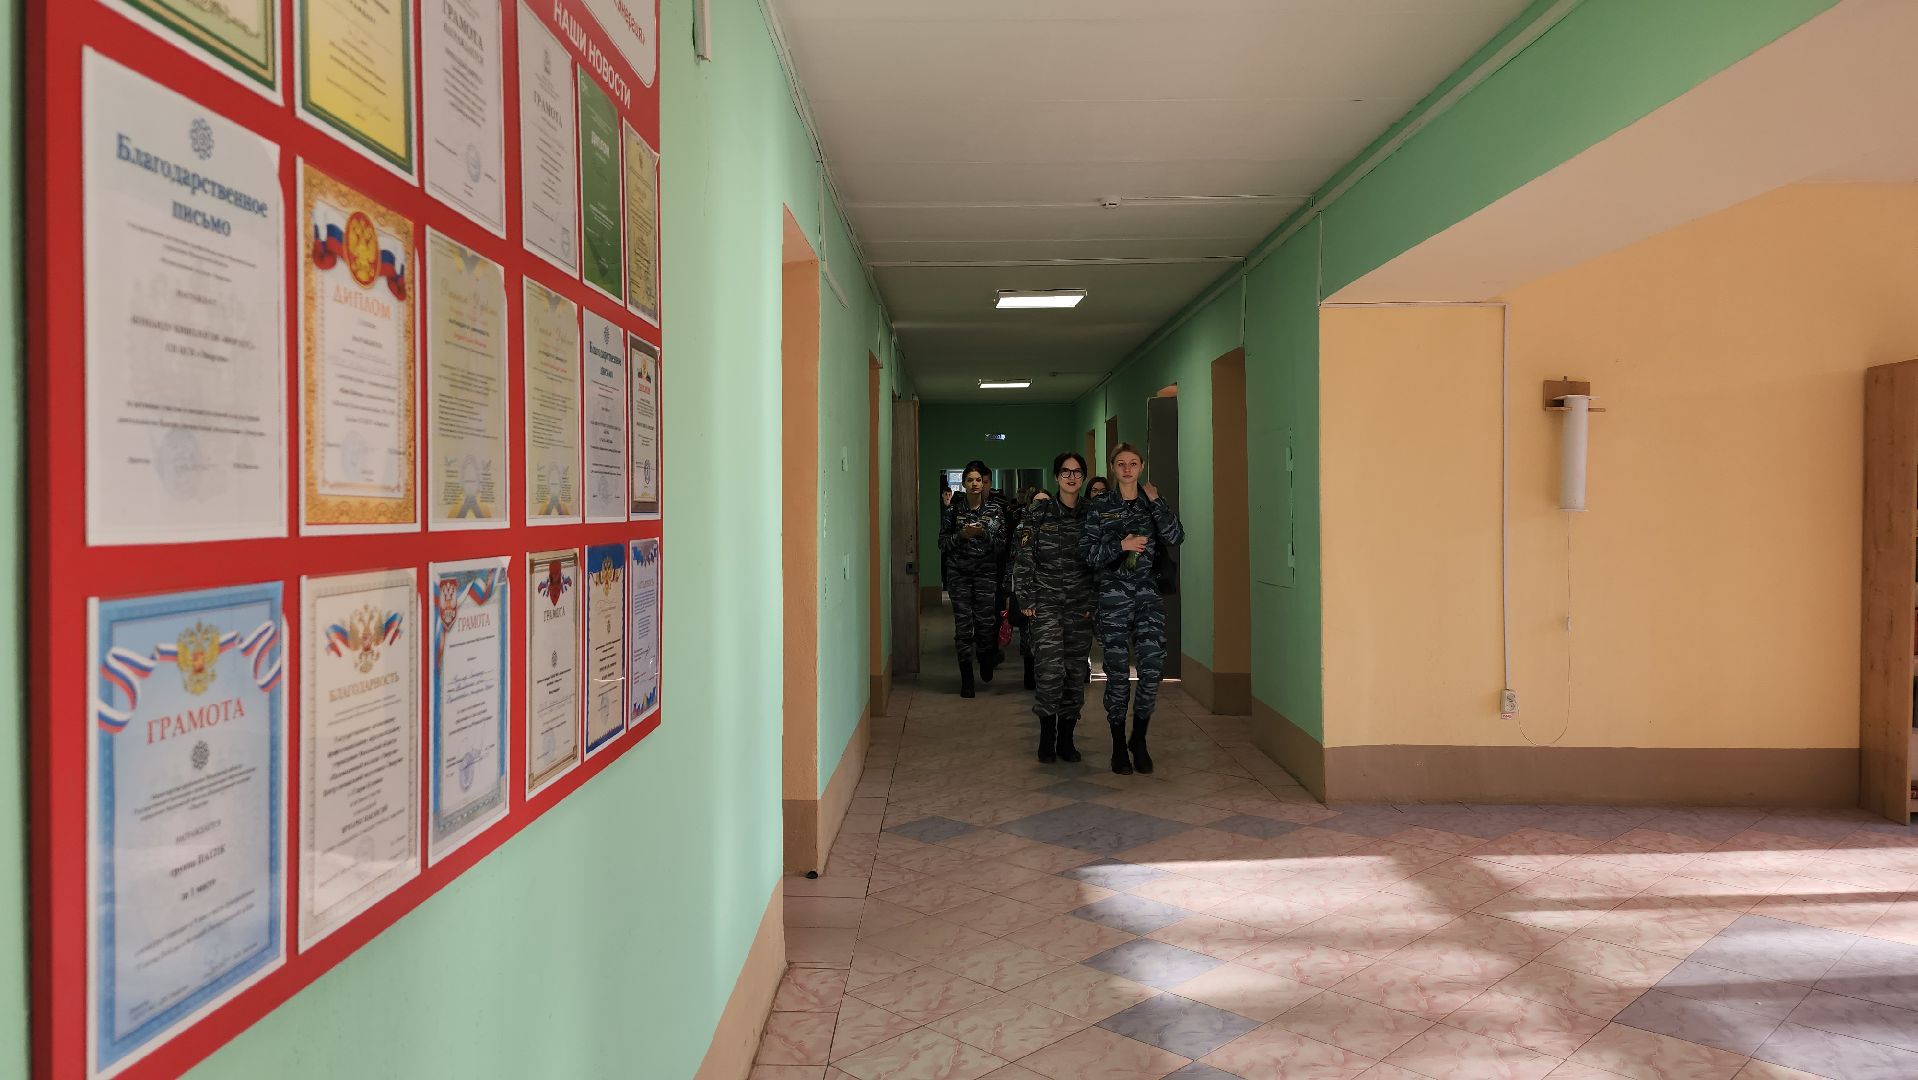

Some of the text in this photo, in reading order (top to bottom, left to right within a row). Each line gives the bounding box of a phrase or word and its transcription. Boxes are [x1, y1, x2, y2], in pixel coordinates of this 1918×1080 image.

[554, 0, 587, 57] НАШИ
[588, 39, 631, 110] НОВОСТИ
[115, 132, 268, 218] Благодарственное
[171, 200, 232, 237] письмо
[333, 285, 392, 320] ДИПЛОМ
[457, 612, 491, 633] ГРАМОТА
[328, 672, 400, 703] БЛАГОДАРНОСТЬ
[146, 697, 246, 745] ГРАМОТА
